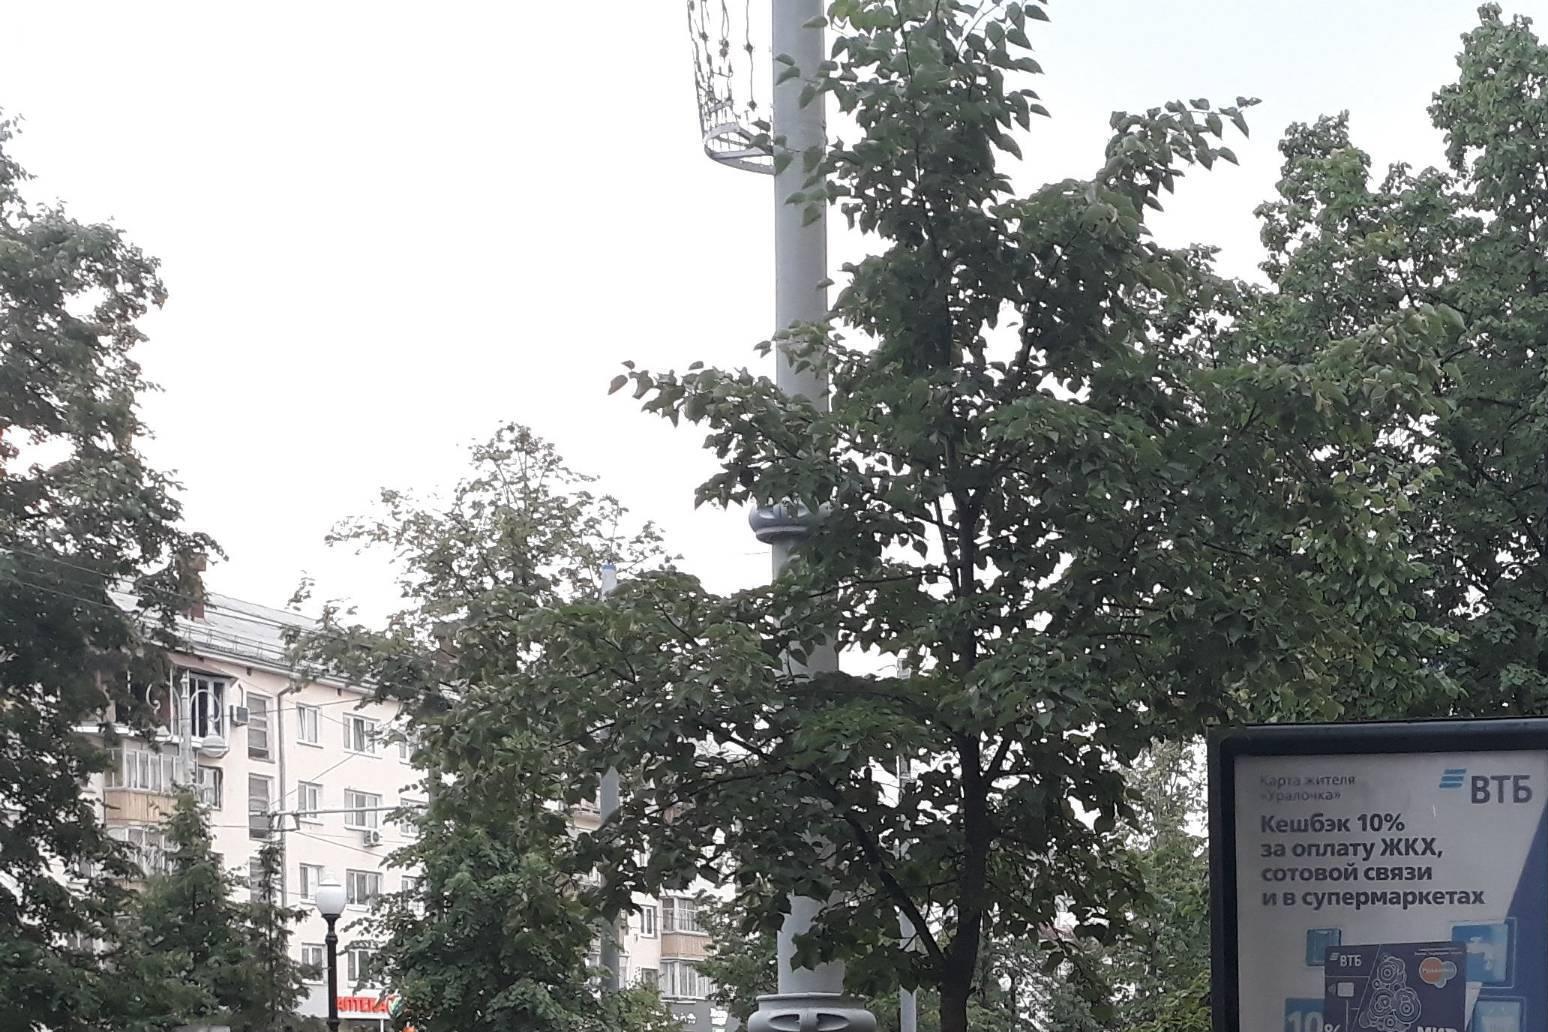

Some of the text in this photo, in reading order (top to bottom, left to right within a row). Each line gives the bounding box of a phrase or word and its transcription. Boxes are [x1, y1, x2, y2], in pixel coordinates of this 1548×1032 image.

[1260, 775, 1355, 789] Карта жителя
[1471, 775, 1532, 804] ВТБ
[1261, 813, 1405, 833] Кешбэк 10%
[1261, 838, 1442, 861] за оплату ЖКХ,
[1262, 863, 1432, 881] сотовой связи
[1262, 889, 1484, 909] и в супермаркетах
[1340, 954, 1361, 966] ВТБ
